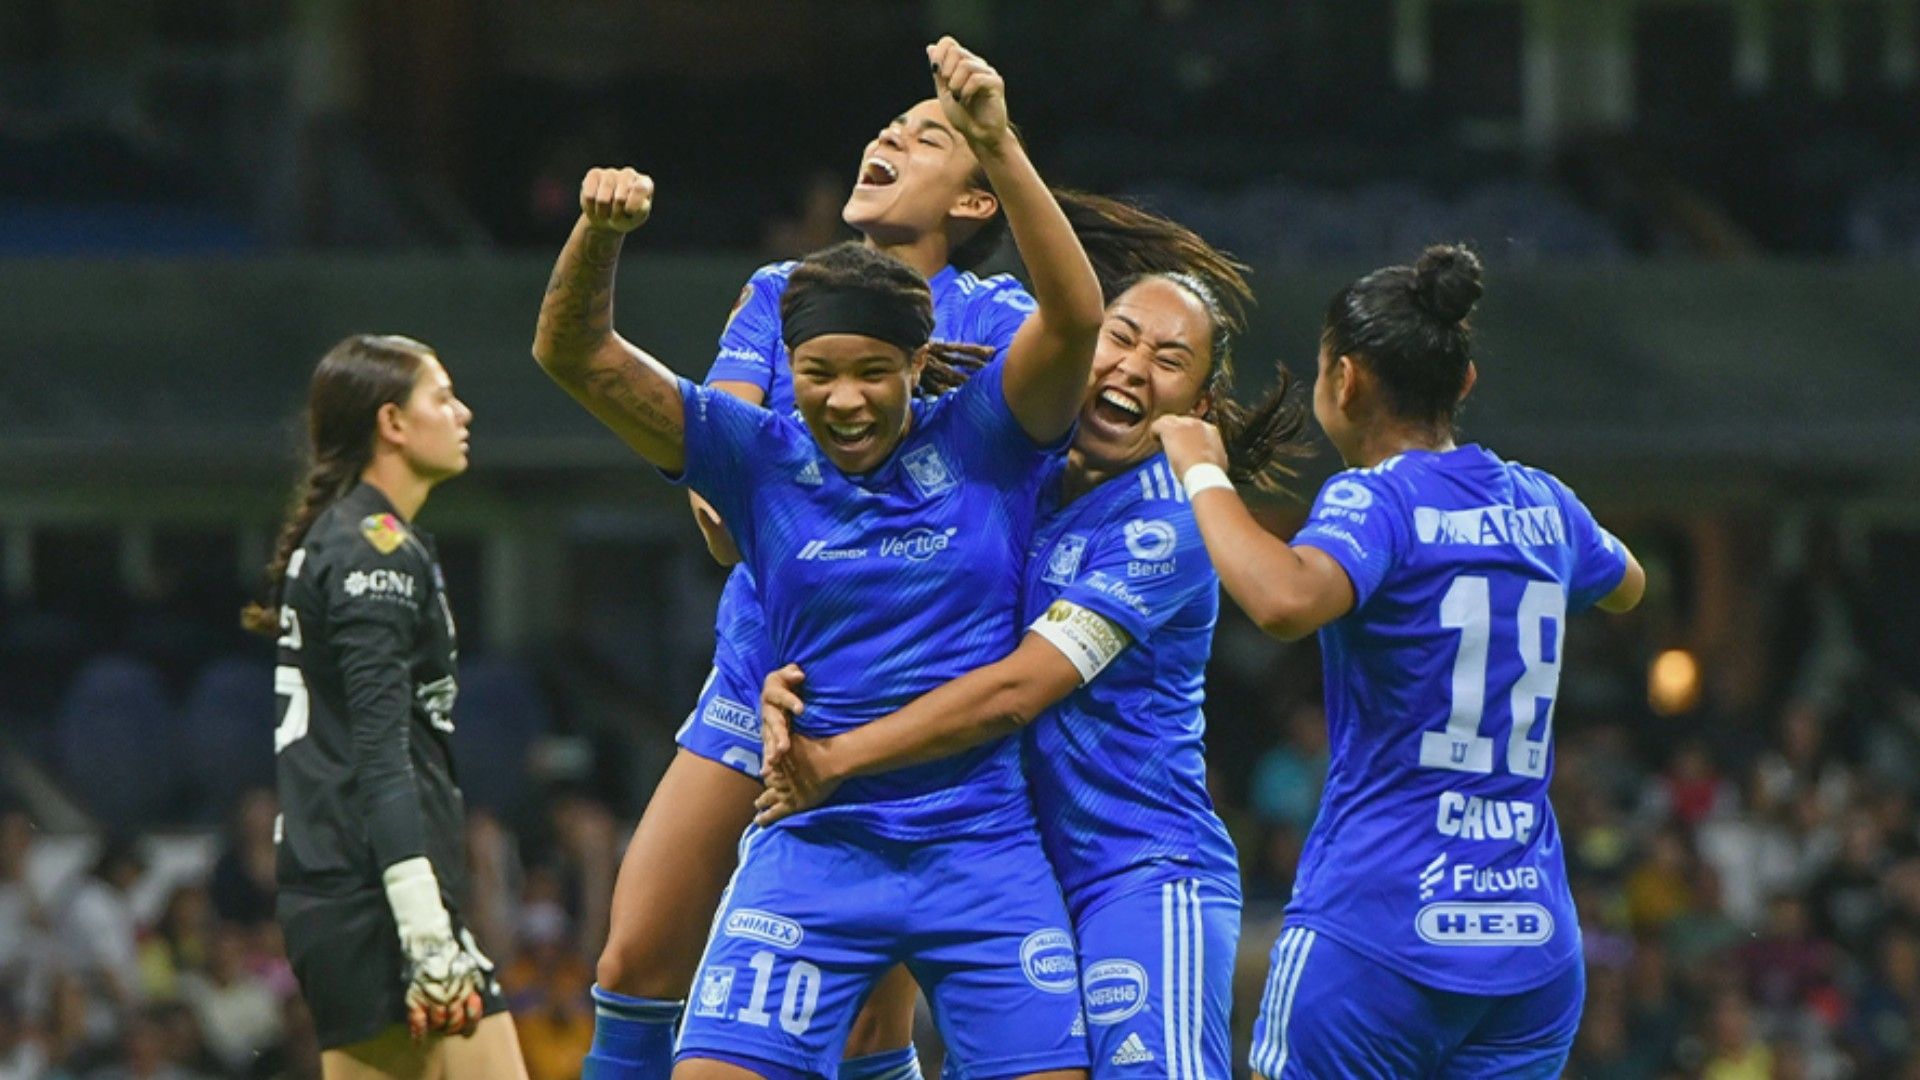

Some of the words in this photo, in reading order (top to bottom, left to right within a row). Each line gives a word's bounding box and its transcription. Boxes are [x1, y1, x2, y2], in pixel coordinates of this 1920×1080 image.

[879, 533, 949, 559] Vertua
[1127, 558, 1176, 578] Berel
[1419, 574, 1568, 780] 18
[1453, 864, 1540, 893] Futura
[729, 914, 794, 940] CHIMEX
[1436, 913, 1541, 934] H-E-B
[738, 950, 821, 1036] 10
